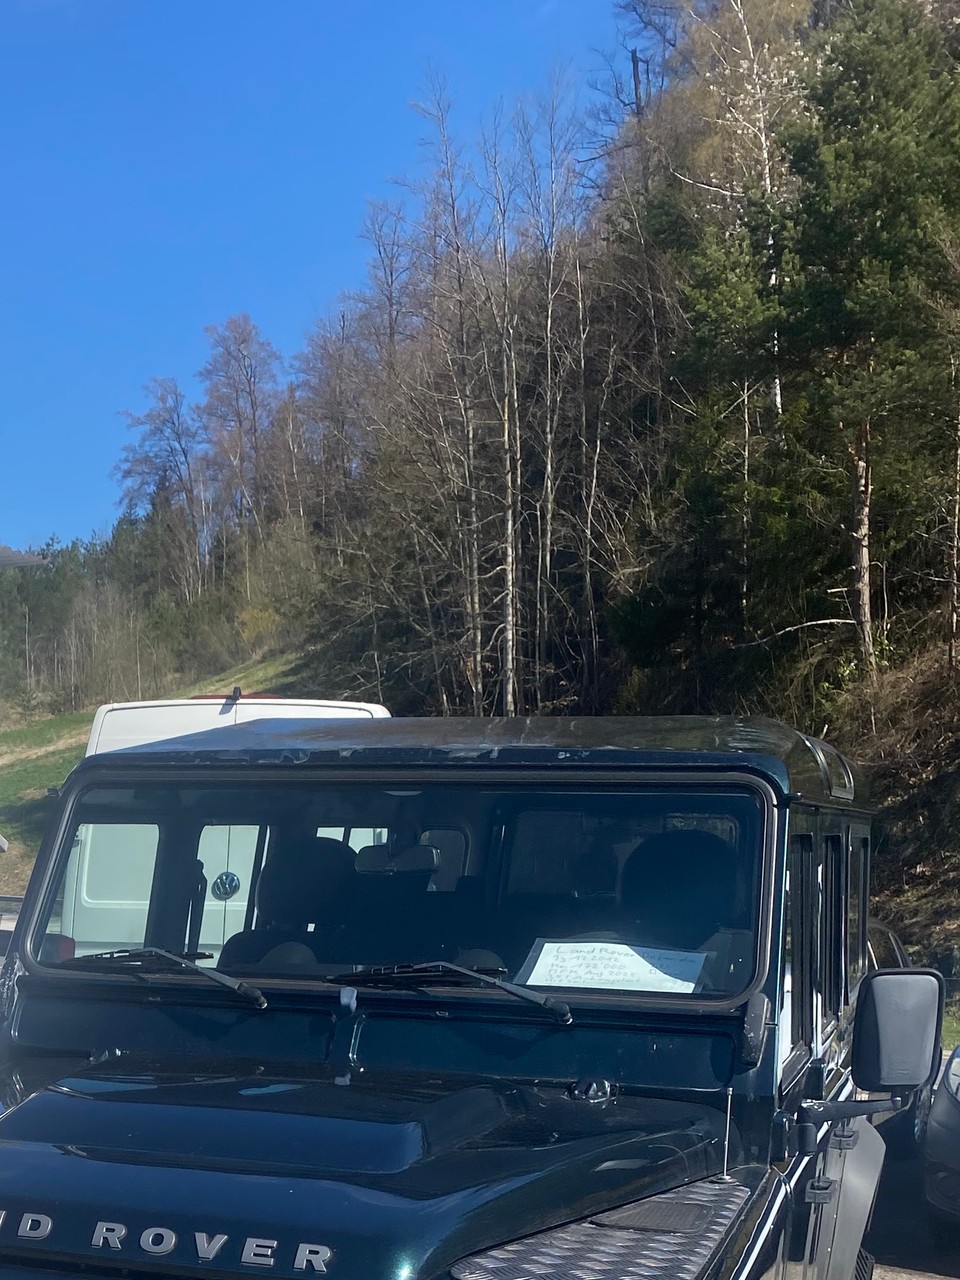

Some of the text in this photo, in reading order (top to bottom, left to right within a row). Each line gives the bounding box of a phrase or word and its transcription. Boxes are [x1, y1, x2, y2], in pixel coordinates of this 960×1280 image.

[556, 946, 595, 955] Land
[599, 948, 637, 958] Rover
[90, 1221, 335, 1273] ROVER
